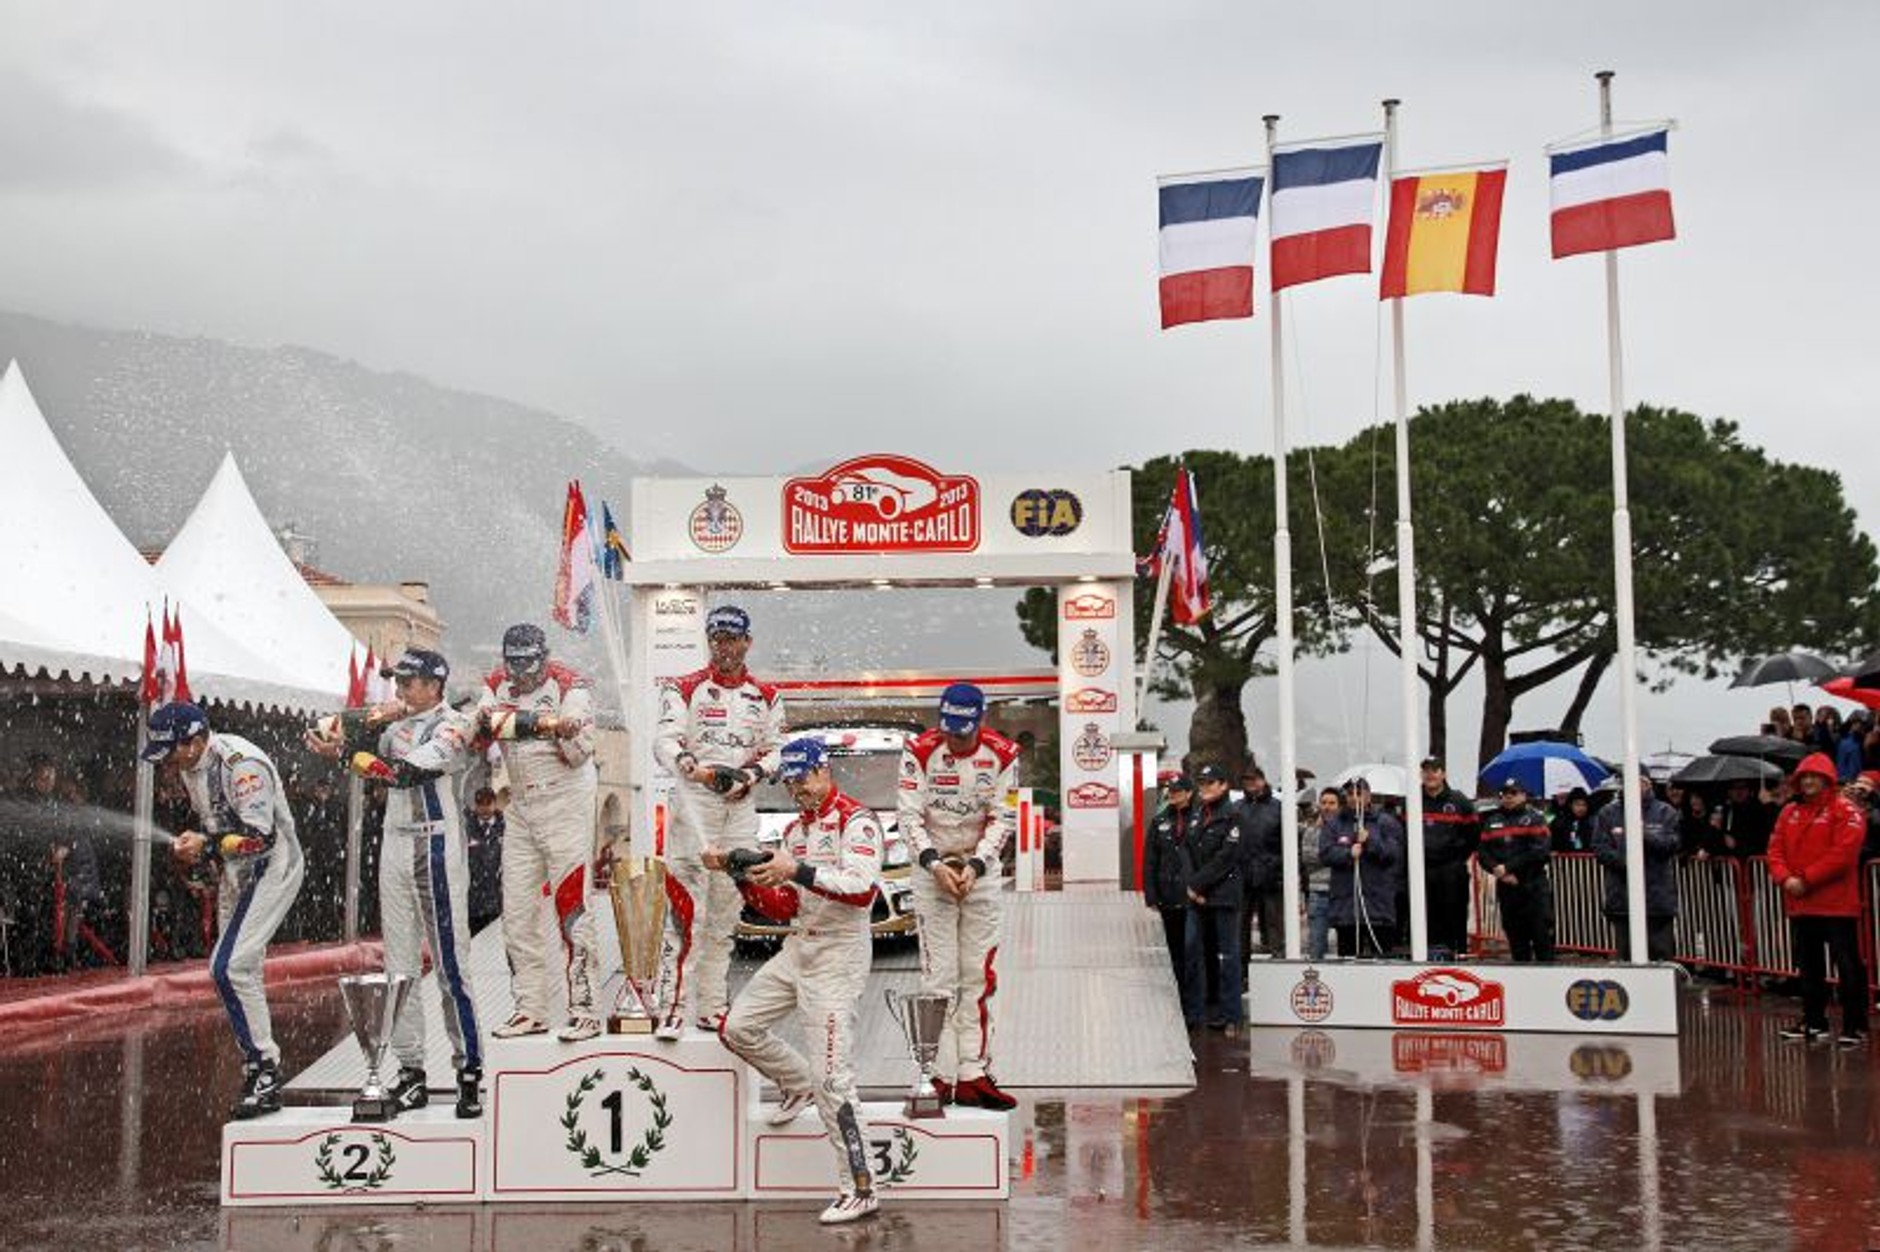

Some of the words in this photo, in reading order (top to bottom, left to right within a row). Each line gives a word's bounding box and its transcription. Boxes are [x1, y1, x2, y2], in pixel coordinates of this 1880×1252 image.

[794, 486, 828, 511] 2013
[939, 483, 968, 508] 2013
[792, 505, 848, 544] RALLYE
[1396, 995, 1430, 1019] RALLYE
[601, 1090, 622, 1154] 1
[343, 1144, 370, 1180] 2
[870, 1140, 892, 1176] 3
